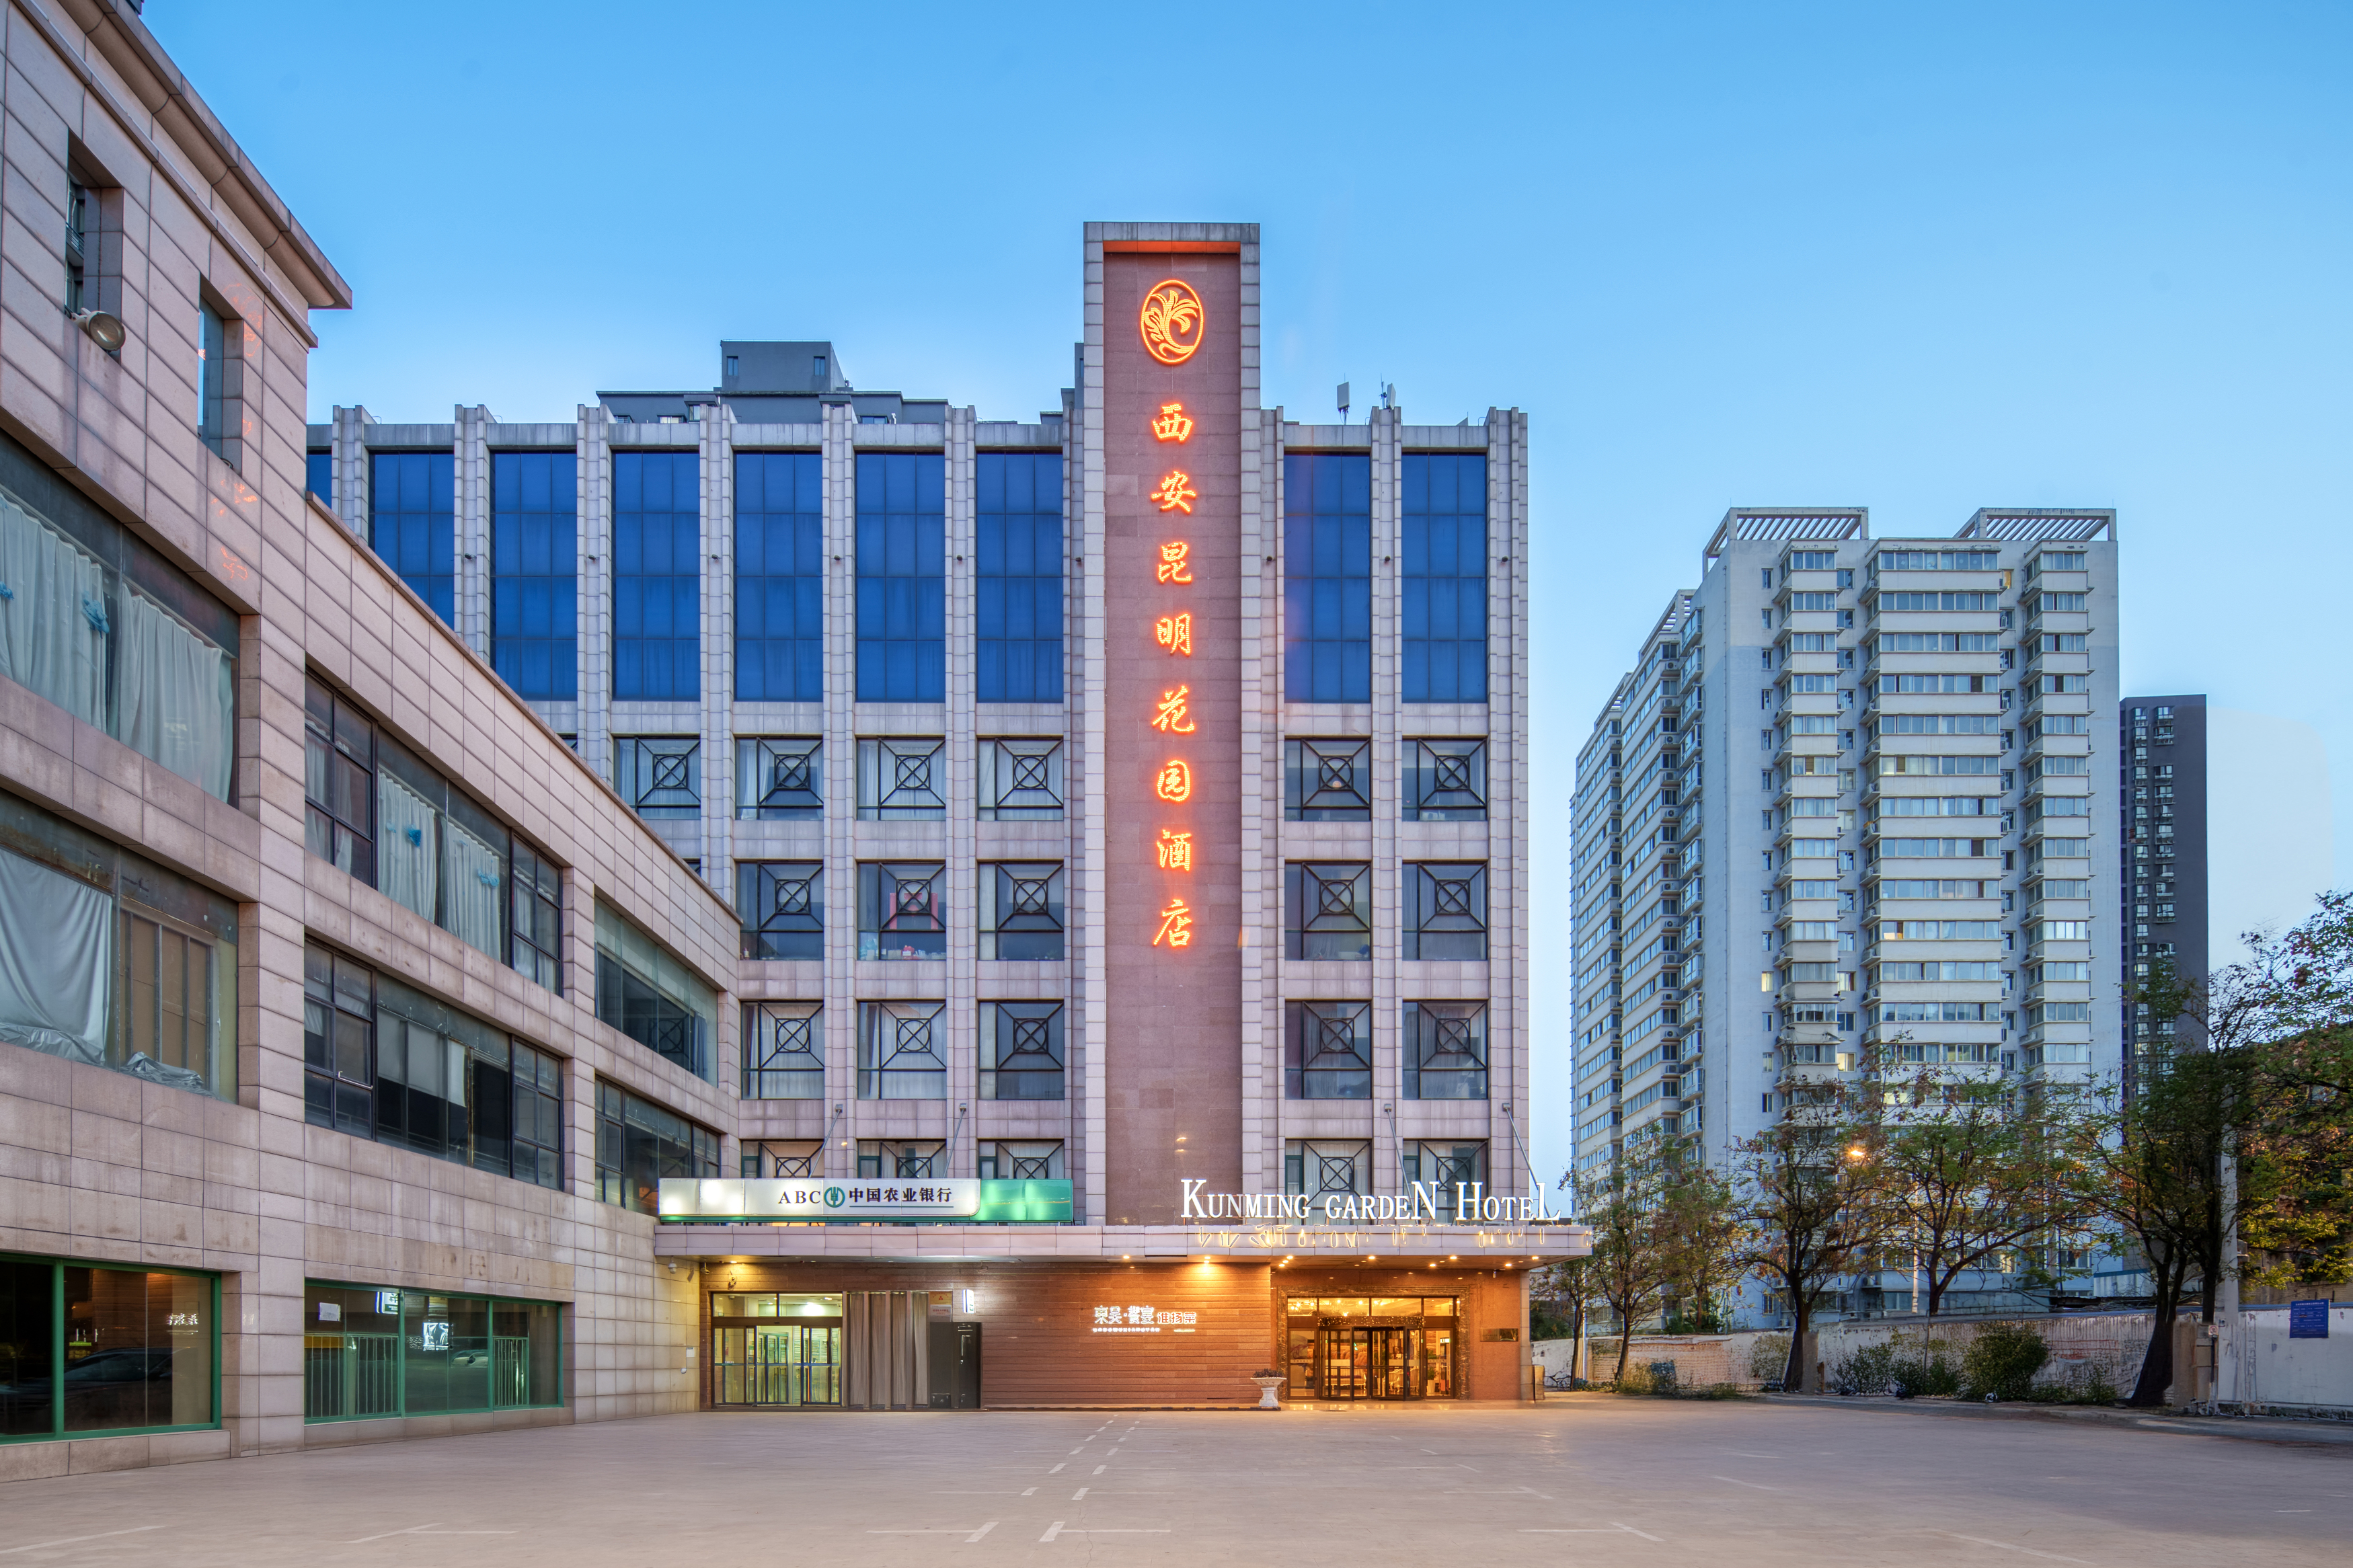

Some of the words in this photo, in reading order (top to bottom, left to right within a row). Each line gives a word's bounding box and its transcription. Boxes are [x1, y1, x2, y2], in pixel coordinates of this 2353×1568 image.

[1151, 403, 1196, 947] 西安昆明花园酒店
[778, 1190, 821, 1204] ABC
[849, 1187, 952, 1203] 中国农业银行
[1180, 1179, 1309, 1218] KUNMING
[1325, 1181, 1440, 1220] GARDEN
[1455, 1181, 1561, 1221] HOTEL
[1157, 1312, 1197, 1325] 淮扬菜
